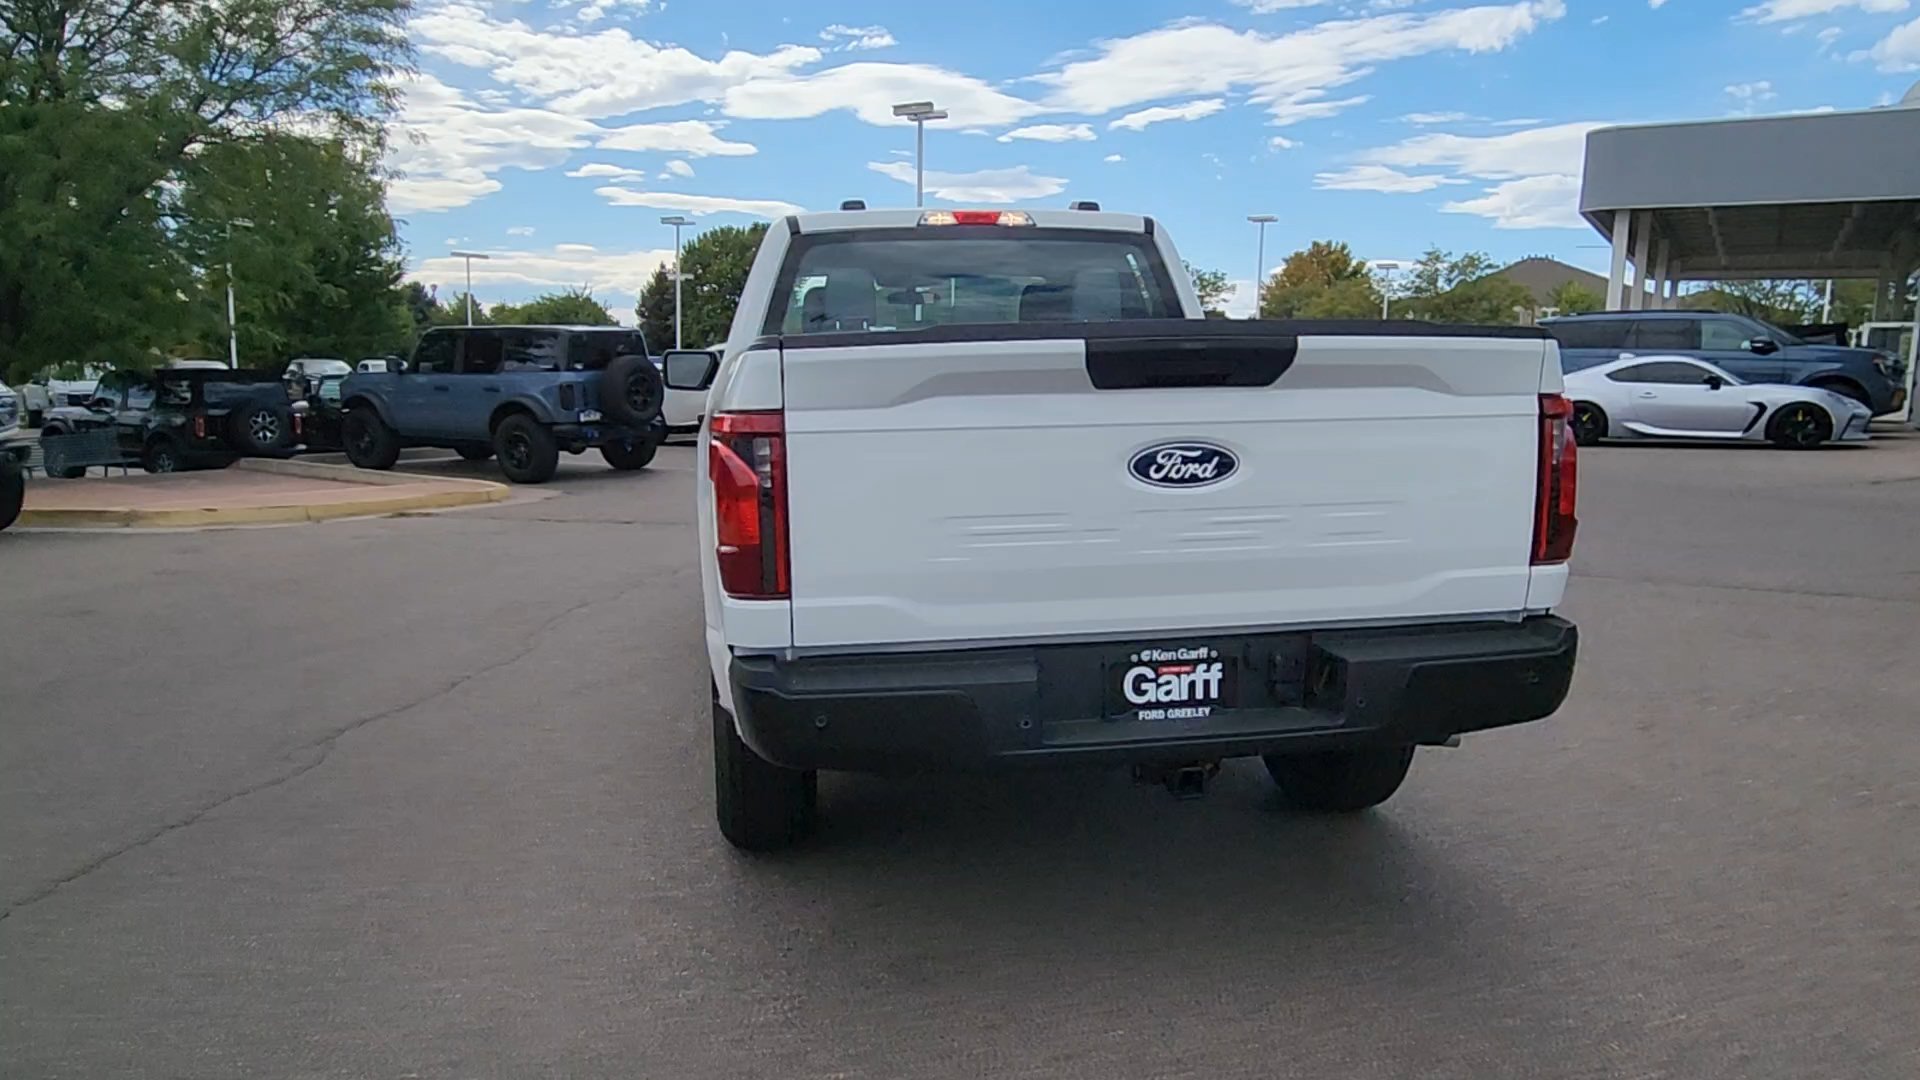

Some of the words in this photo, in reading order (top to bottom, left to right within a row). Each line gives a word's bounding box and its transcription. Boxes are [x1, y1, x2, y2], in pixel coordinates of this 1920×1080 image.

[1149, 449, 1219, 479] Ford
[1152, 649, 1176, 661] Ken
[1177, 647, 1208, 660] Garff
[1123, 662, 1223, 704] Garff
[1138, 708, 1165, 720] FORD
[1167, 707, 1211, 719] GREELEY
